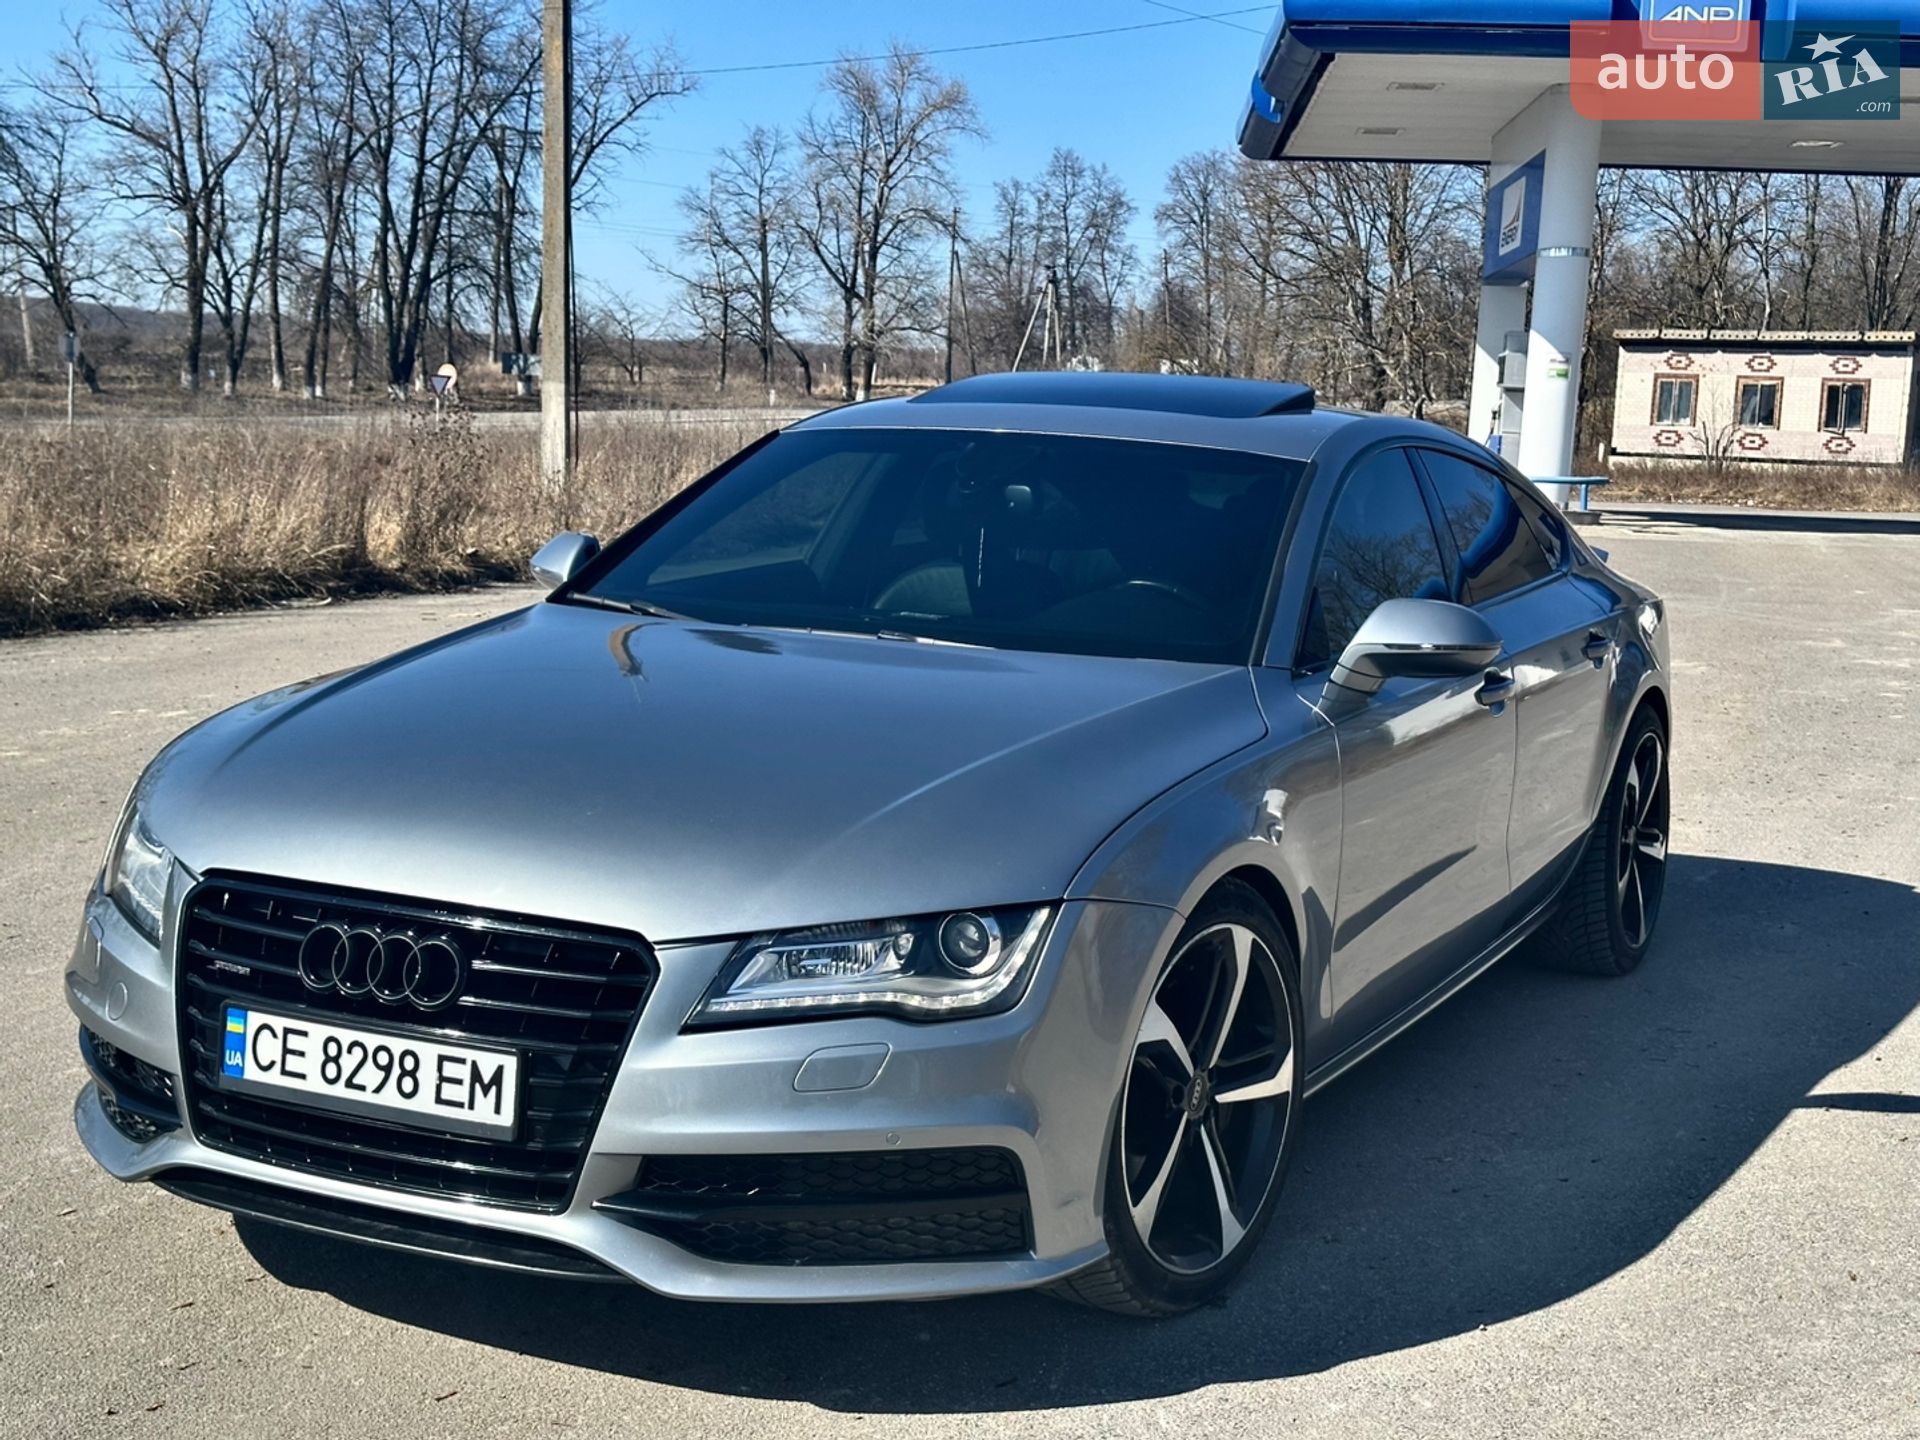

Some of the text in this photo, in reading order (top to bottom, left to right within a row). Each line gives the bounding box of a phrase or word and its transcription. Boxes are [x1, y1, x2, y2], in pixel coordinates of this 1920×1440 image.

[225, 1049, 243, 1067] UA
[252, 1022, 505, 1116] CE 8298 EM
